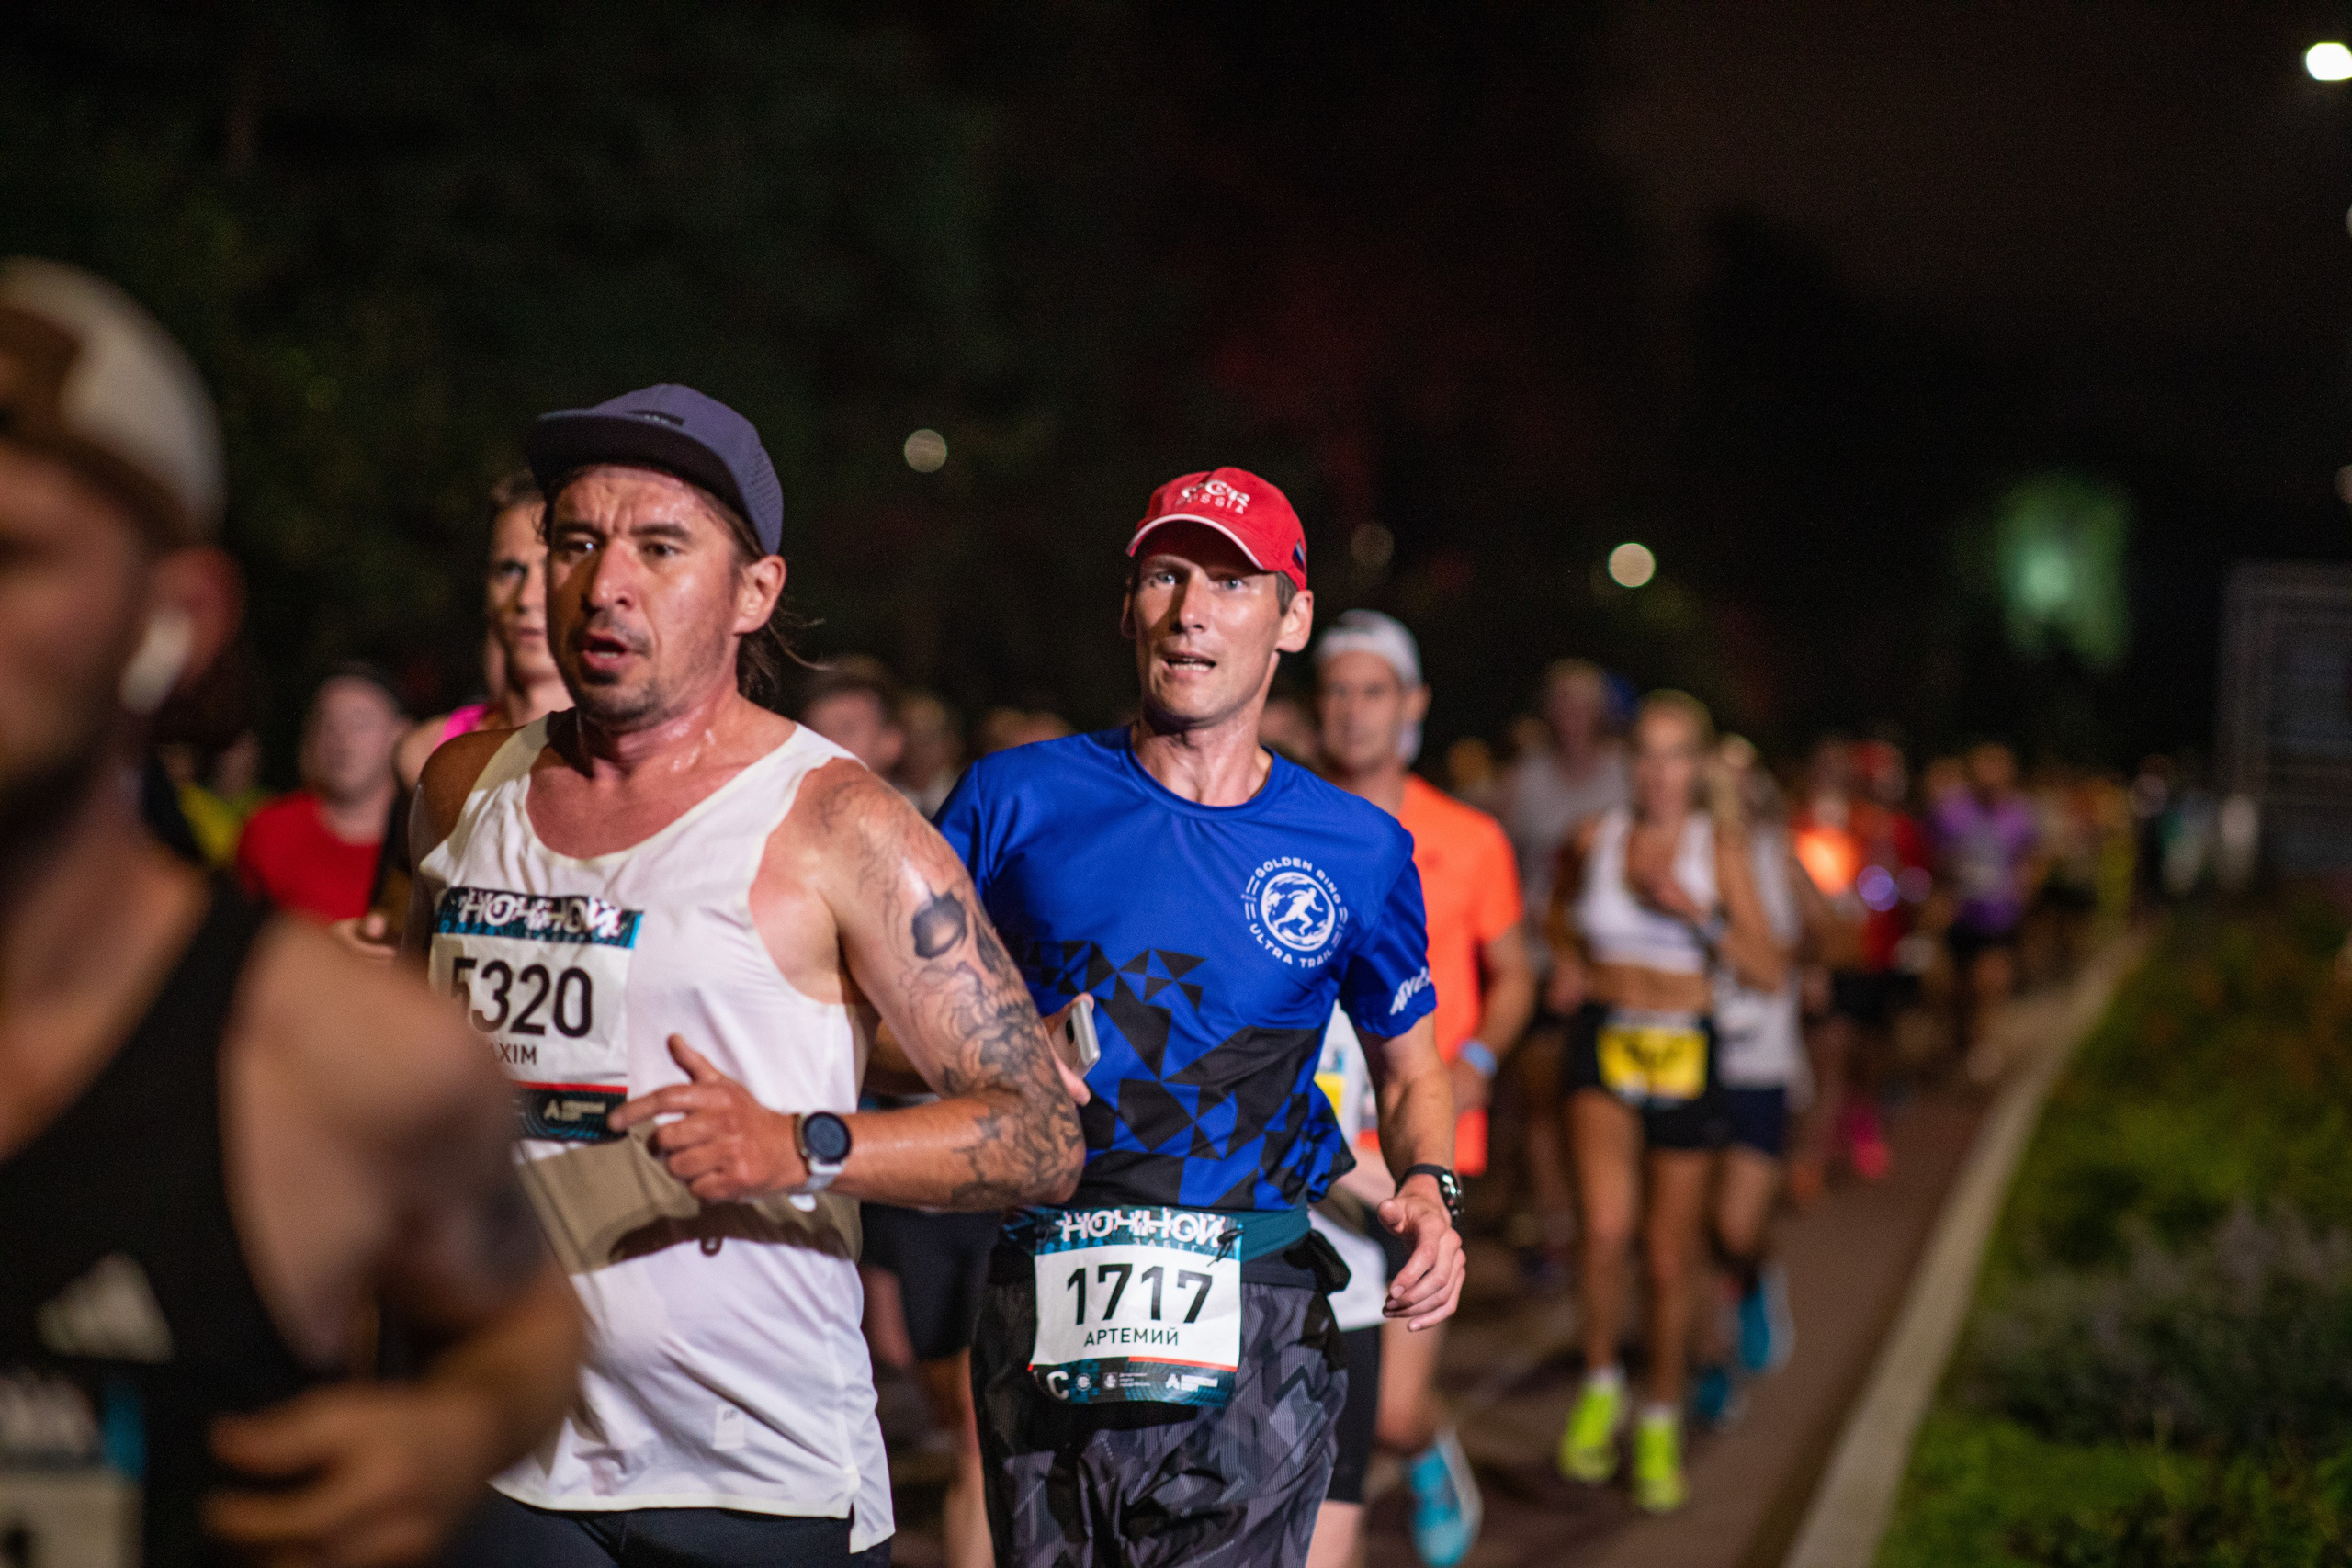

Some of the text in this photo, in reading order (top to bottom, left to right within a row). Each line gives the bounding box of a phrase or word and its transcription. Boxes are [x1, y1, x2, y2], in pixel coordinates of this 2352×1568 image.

[1255, 856, 1341, 904] GOLDEN RING
[1250, 923, 1333, 968] ULTRA TRAIL
[491, 1042, 537, 1065] XIM
[1066, 1263, 1213, 1325] 1717
[1084, 1327, 1179, 1347] АРТЕМИЙ
